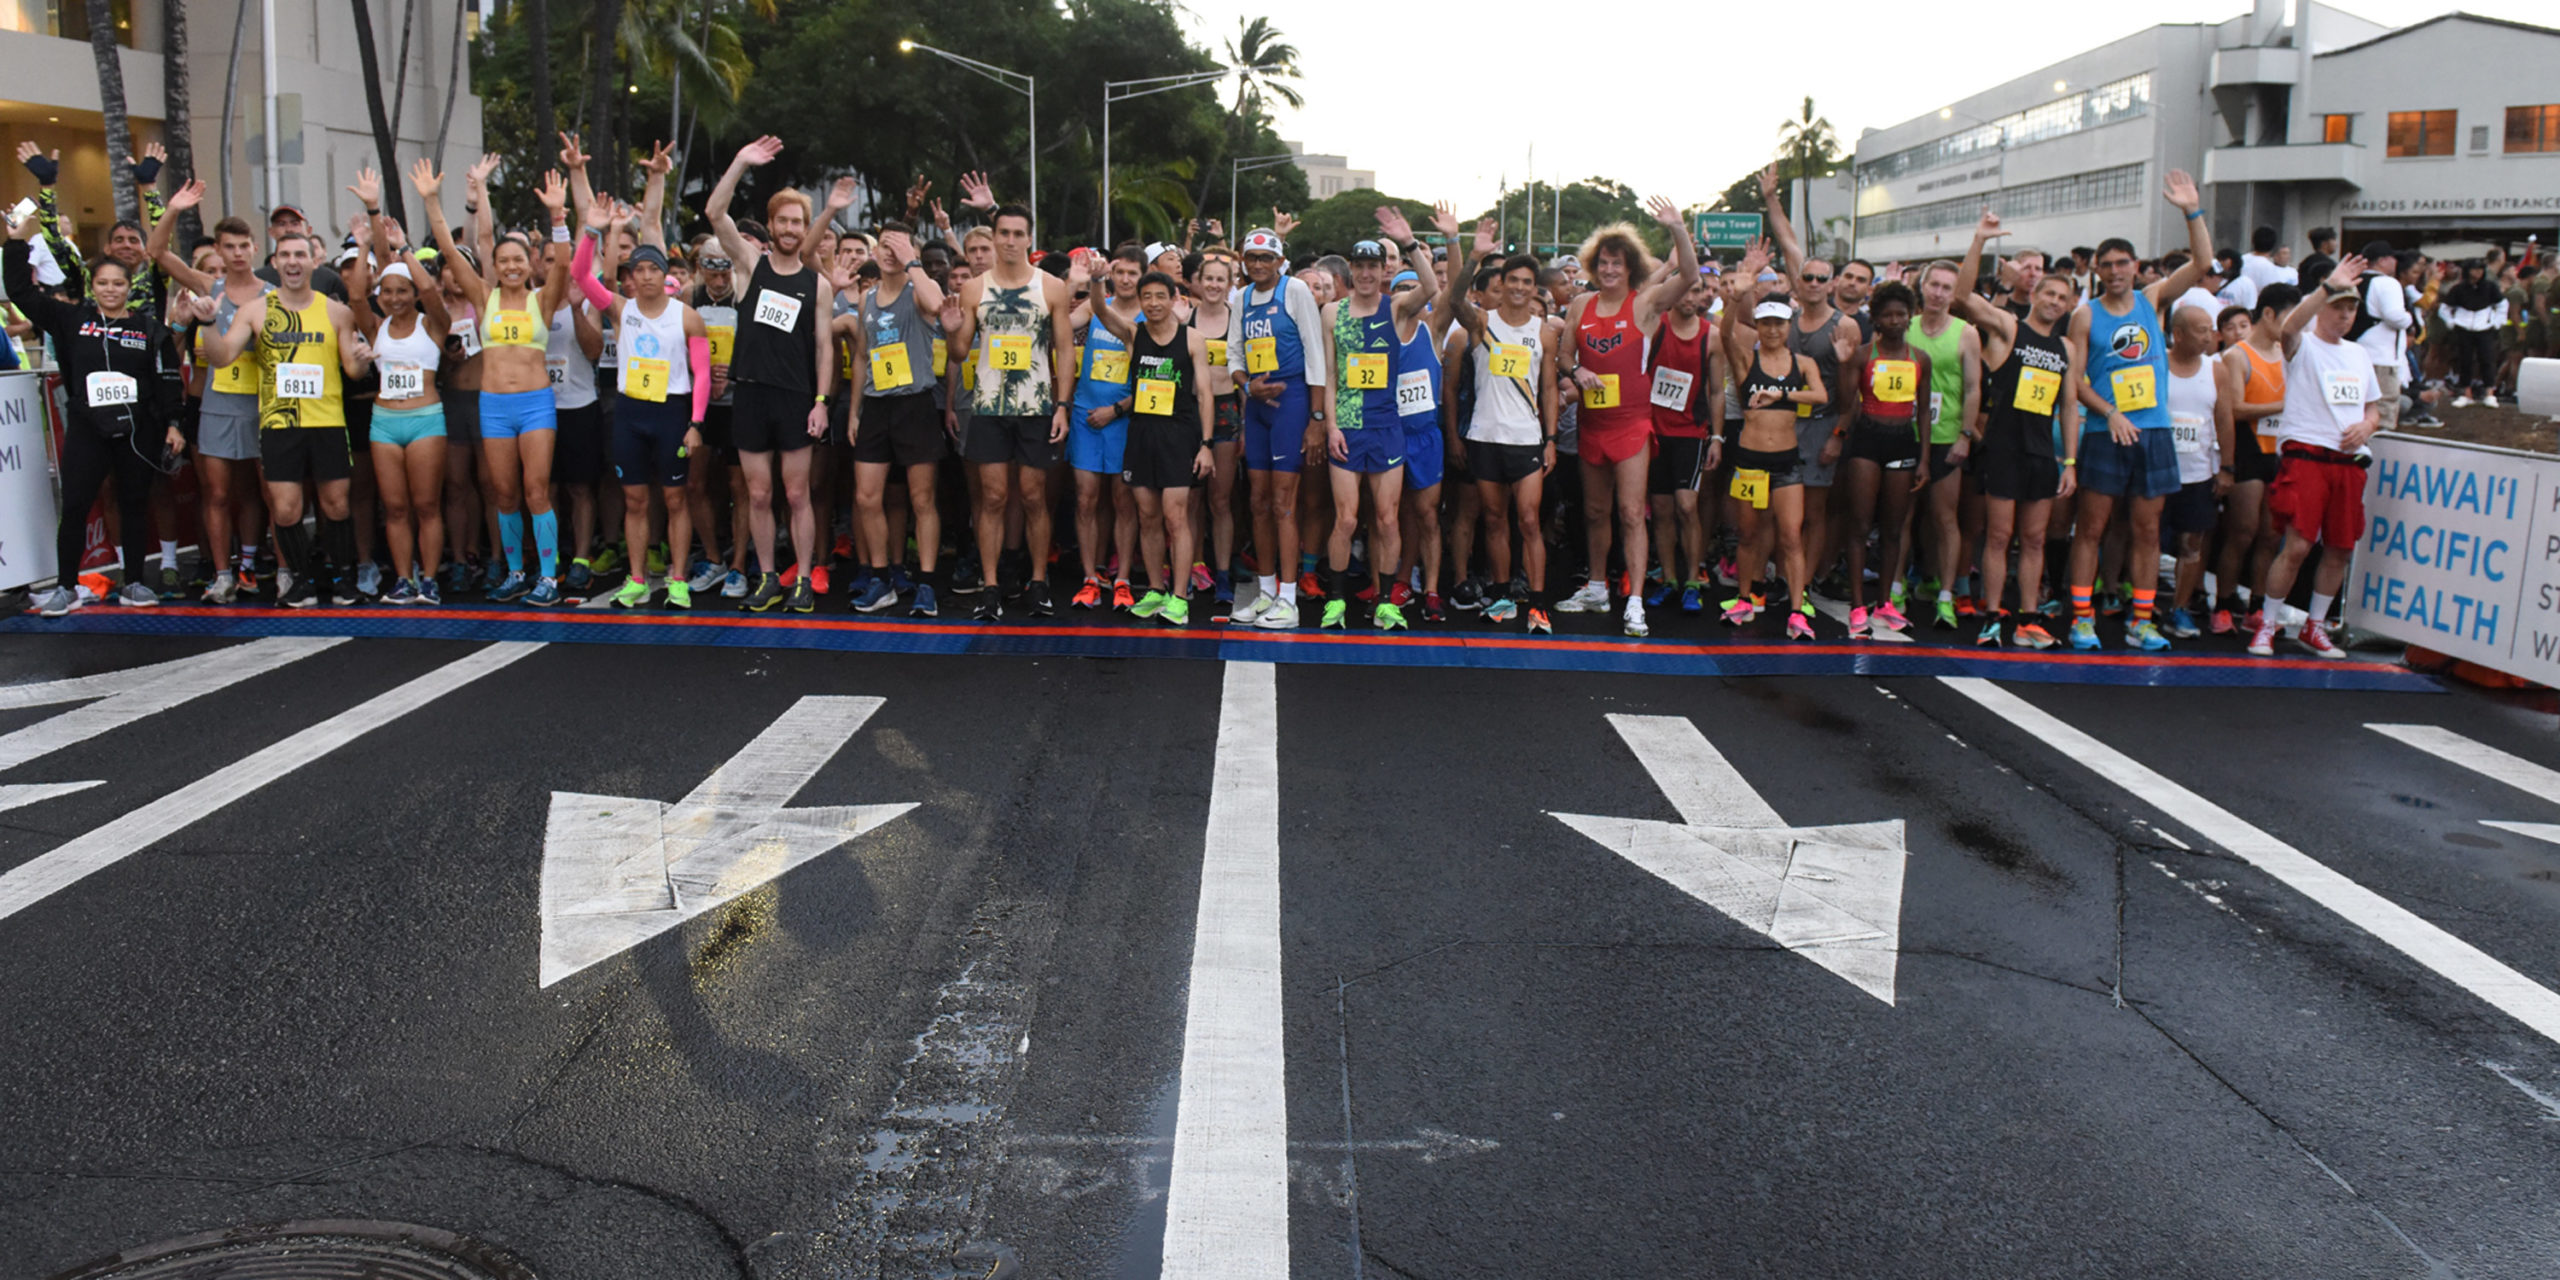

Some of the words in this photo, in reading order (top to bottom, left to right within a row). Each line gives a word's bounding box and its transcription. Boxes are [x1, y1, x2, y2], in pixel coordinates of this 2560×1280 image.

[2341, 200, 2406, 211] HARBORS
[2413, 199, 2476, 210] PARKING
[1729, 219, 1757, 229] Tower
[760, 305, 790, 327] 3082
[504, 326, 519, 340] 18
[1245, 319, 1273, 339] USA
[1586, 332, 1623, 354] USA
[1003, 351, 1018, 365] 39
[232, 366, 240, 381] 9
[885, 361, 893, 376] 8
[1104, 365, 1112, 379] 2
[1501, 359, 1516, 373] 37
[388, 374, 416, 389] 6810
[642, 374, 650, 388] 6
[1361, 369, 1375, 385] 32
[1888, 376, 1903, 390] 16
[96, 385, 129, 401] 9669
[284, 378, 316, 395] 6811
[1657, 381, 1684, 400] 1777
[2031, 385, 2046, 401] 35
[2128, 383, 2145, 399] 15
[2333, 385, 2360, 400] 2423
[1400, 385, 1428, 404] 5272
[1593, 390, 1607, 405] 21
[1149, 395, 1157, 410] 5
[0, 399, 27, 425] NI
[1740, 484, 1754, 498] 24
[2369, 515, 2509, 582] PACIFIC
[2361, 572, 2499, 646] HEALTH
[2533, 630, 2560, 664] W
